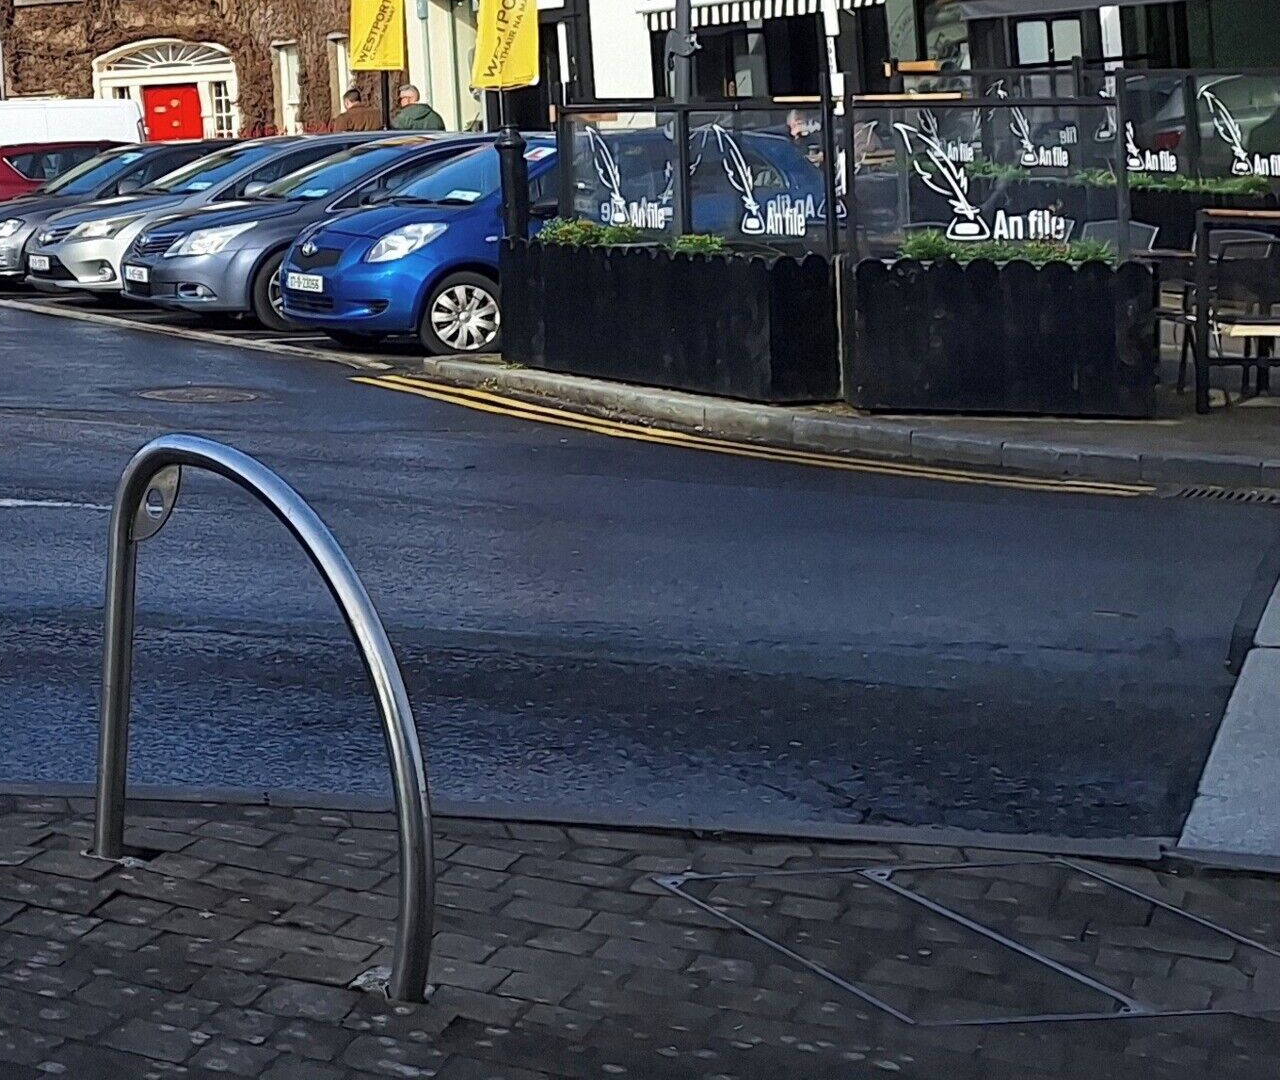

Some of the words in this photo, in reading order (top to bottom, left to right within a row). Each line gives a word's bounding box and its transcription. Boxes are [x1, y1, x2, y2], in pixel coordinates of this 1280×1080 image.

[1039, 146, 1050, 166] An
[1145, 149, 1159, 171] An
[1254, 153, 1269, 176] An
[993, 209, 1024, 240] An
[1028, 209, 1065, 240] file
